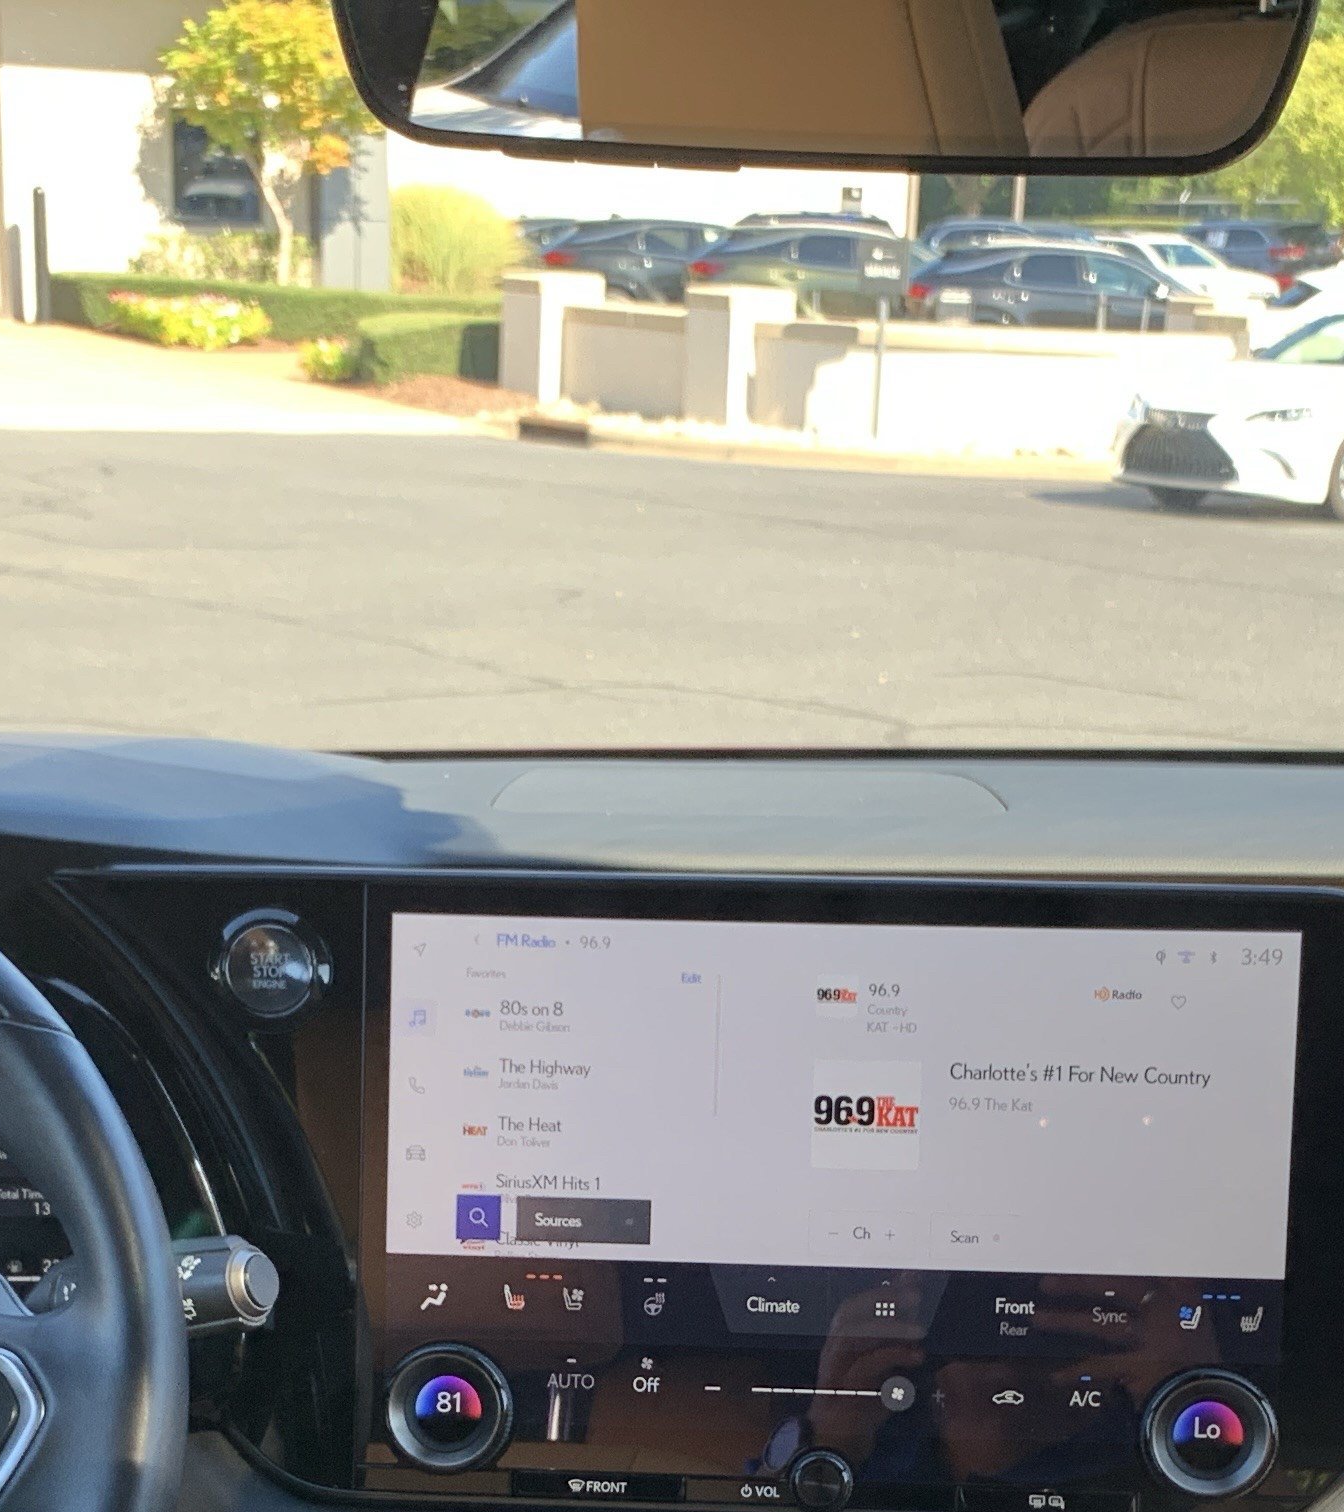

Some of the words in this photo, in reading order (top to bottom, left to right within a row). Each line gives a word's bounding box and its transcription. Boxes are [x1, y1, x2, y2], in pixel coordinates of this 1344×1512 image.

[497, 933, 518, 947] FM
[521, 933, 556, 948] Radio
[579, 935, 611, 949] 96.9
[1241, 948, 1283, 966] 3:49
[466, 967, 507, 979] Favorites
[680, 972, 701, 984] Edit
[868, 983, 900, 998] 96.9
[1112, 989, 1143, 1000] Radio
[499, 1000, 529, 1016] 80s
[531, 1005, 550, 1017] on
[552, 1001, 564, 1017] 8
[867, 1004, 908, 1017] Country
[498, 1057, 526, 1074] The
[529, 1058, 592, 1079] Highway
[949, 1062, 1038, 1083] Charlotte's
[1042, 1064, 1063, 1083] #1
[1068, 1065, 1095, 1083] For
[1099, 1066, 1139, 1085] New
[1143, 1066, 1212, 1089] Country
[949, 1096, 981, 1112] 96.9
[984, 1097, 1008, 1112] The
[1010, 1098, 1034, 1113] Kat
[497, 1115, 524, 1132] The
[528, 1116, 562, 1133] Heat
[876, 1105, 919, 1127] KAT
[496, 1135, 517, 1147] Don
[496, 1173, 557, 1190] SiriusXM
[561, 1174, 590, 1191] Hits
[595, 1176, 601, 1191] 1
[534, 1211, 583, 1228] Sources
[852, 1226, 872, 1240] Ch
[950, 1230, 980, 1244] Scan
[746, 1295, 801, 1314] Climate
[995, 1297, 1035, 1315] Front
[1092, 1306, 1128, 1326] Sync
[1000, 1321, 1029, 1337] Rear
[546, 1372, 596, 1390] AUTO
[632, 1376, 661, 1394] Off
[434, 1391, 462, 1414] 81
[1069, 1390, 1102, 1408] A/C
[1193, 1415, 1222, 1440] Lo
[585, 1480, 628, 1494] FRONT
[754, 1485, 781, 1498] VOL
